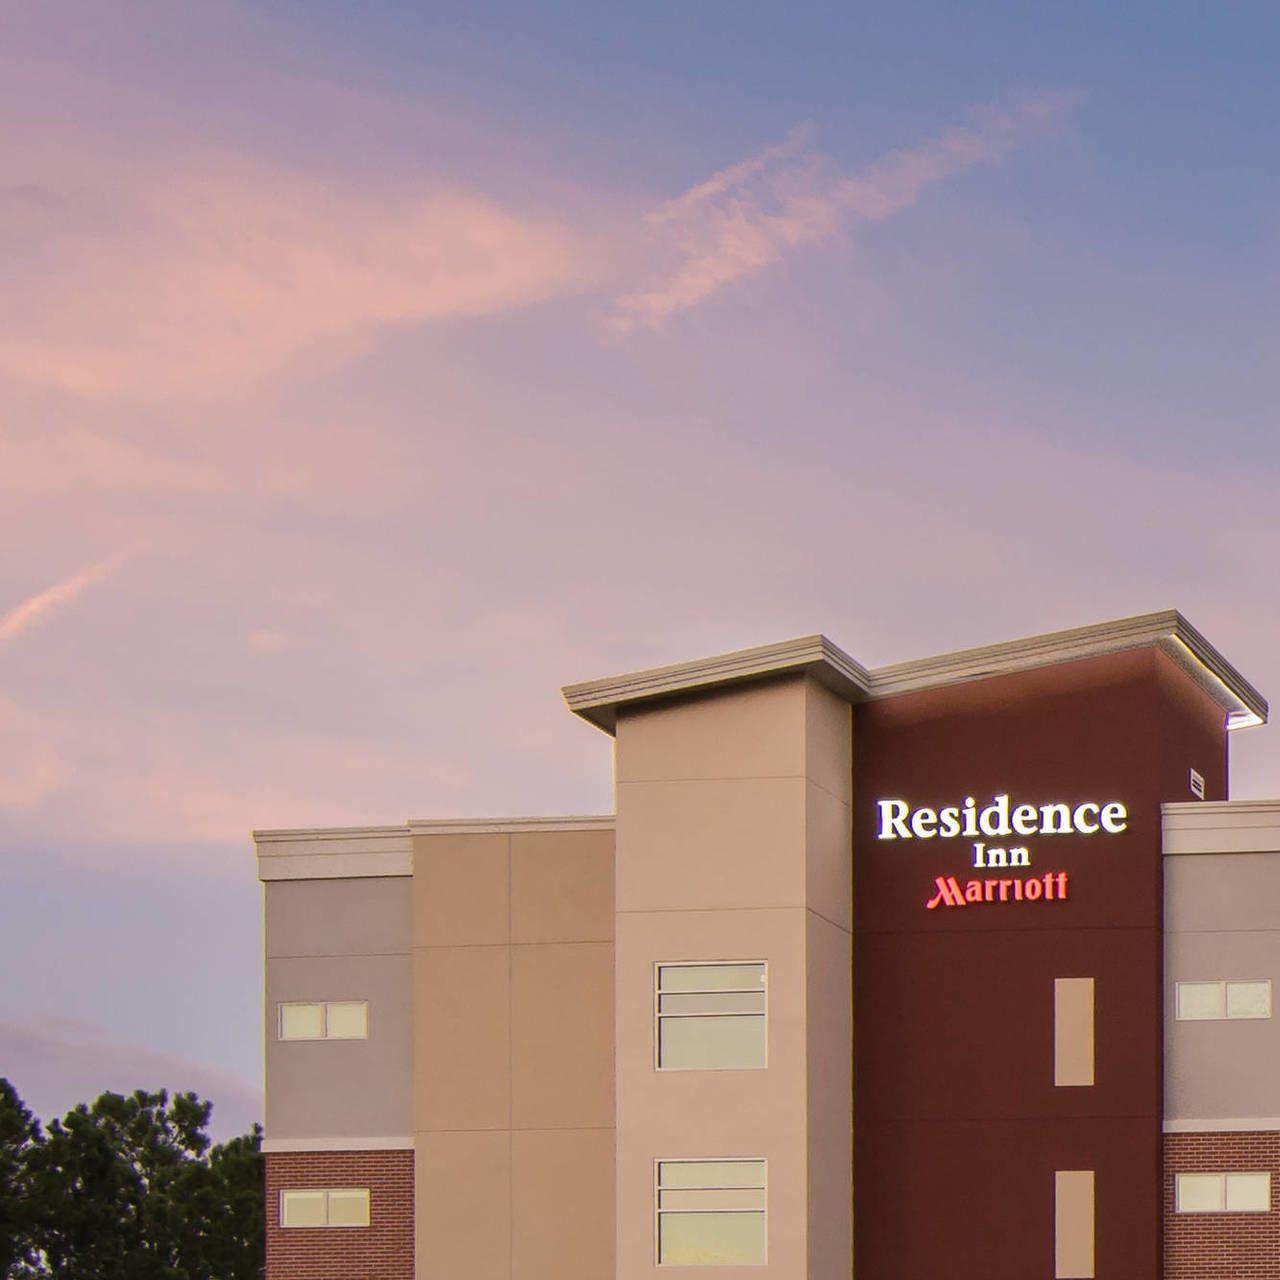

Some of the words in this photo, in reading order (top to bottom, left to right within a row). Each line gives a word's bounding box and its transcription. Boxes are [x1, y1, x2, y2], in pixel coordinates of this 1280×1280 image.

[876, 794, 1128, 840] Residence
[973, 843, 1031, 868] Inn
[926, 872, 1068, 909] Marriott
